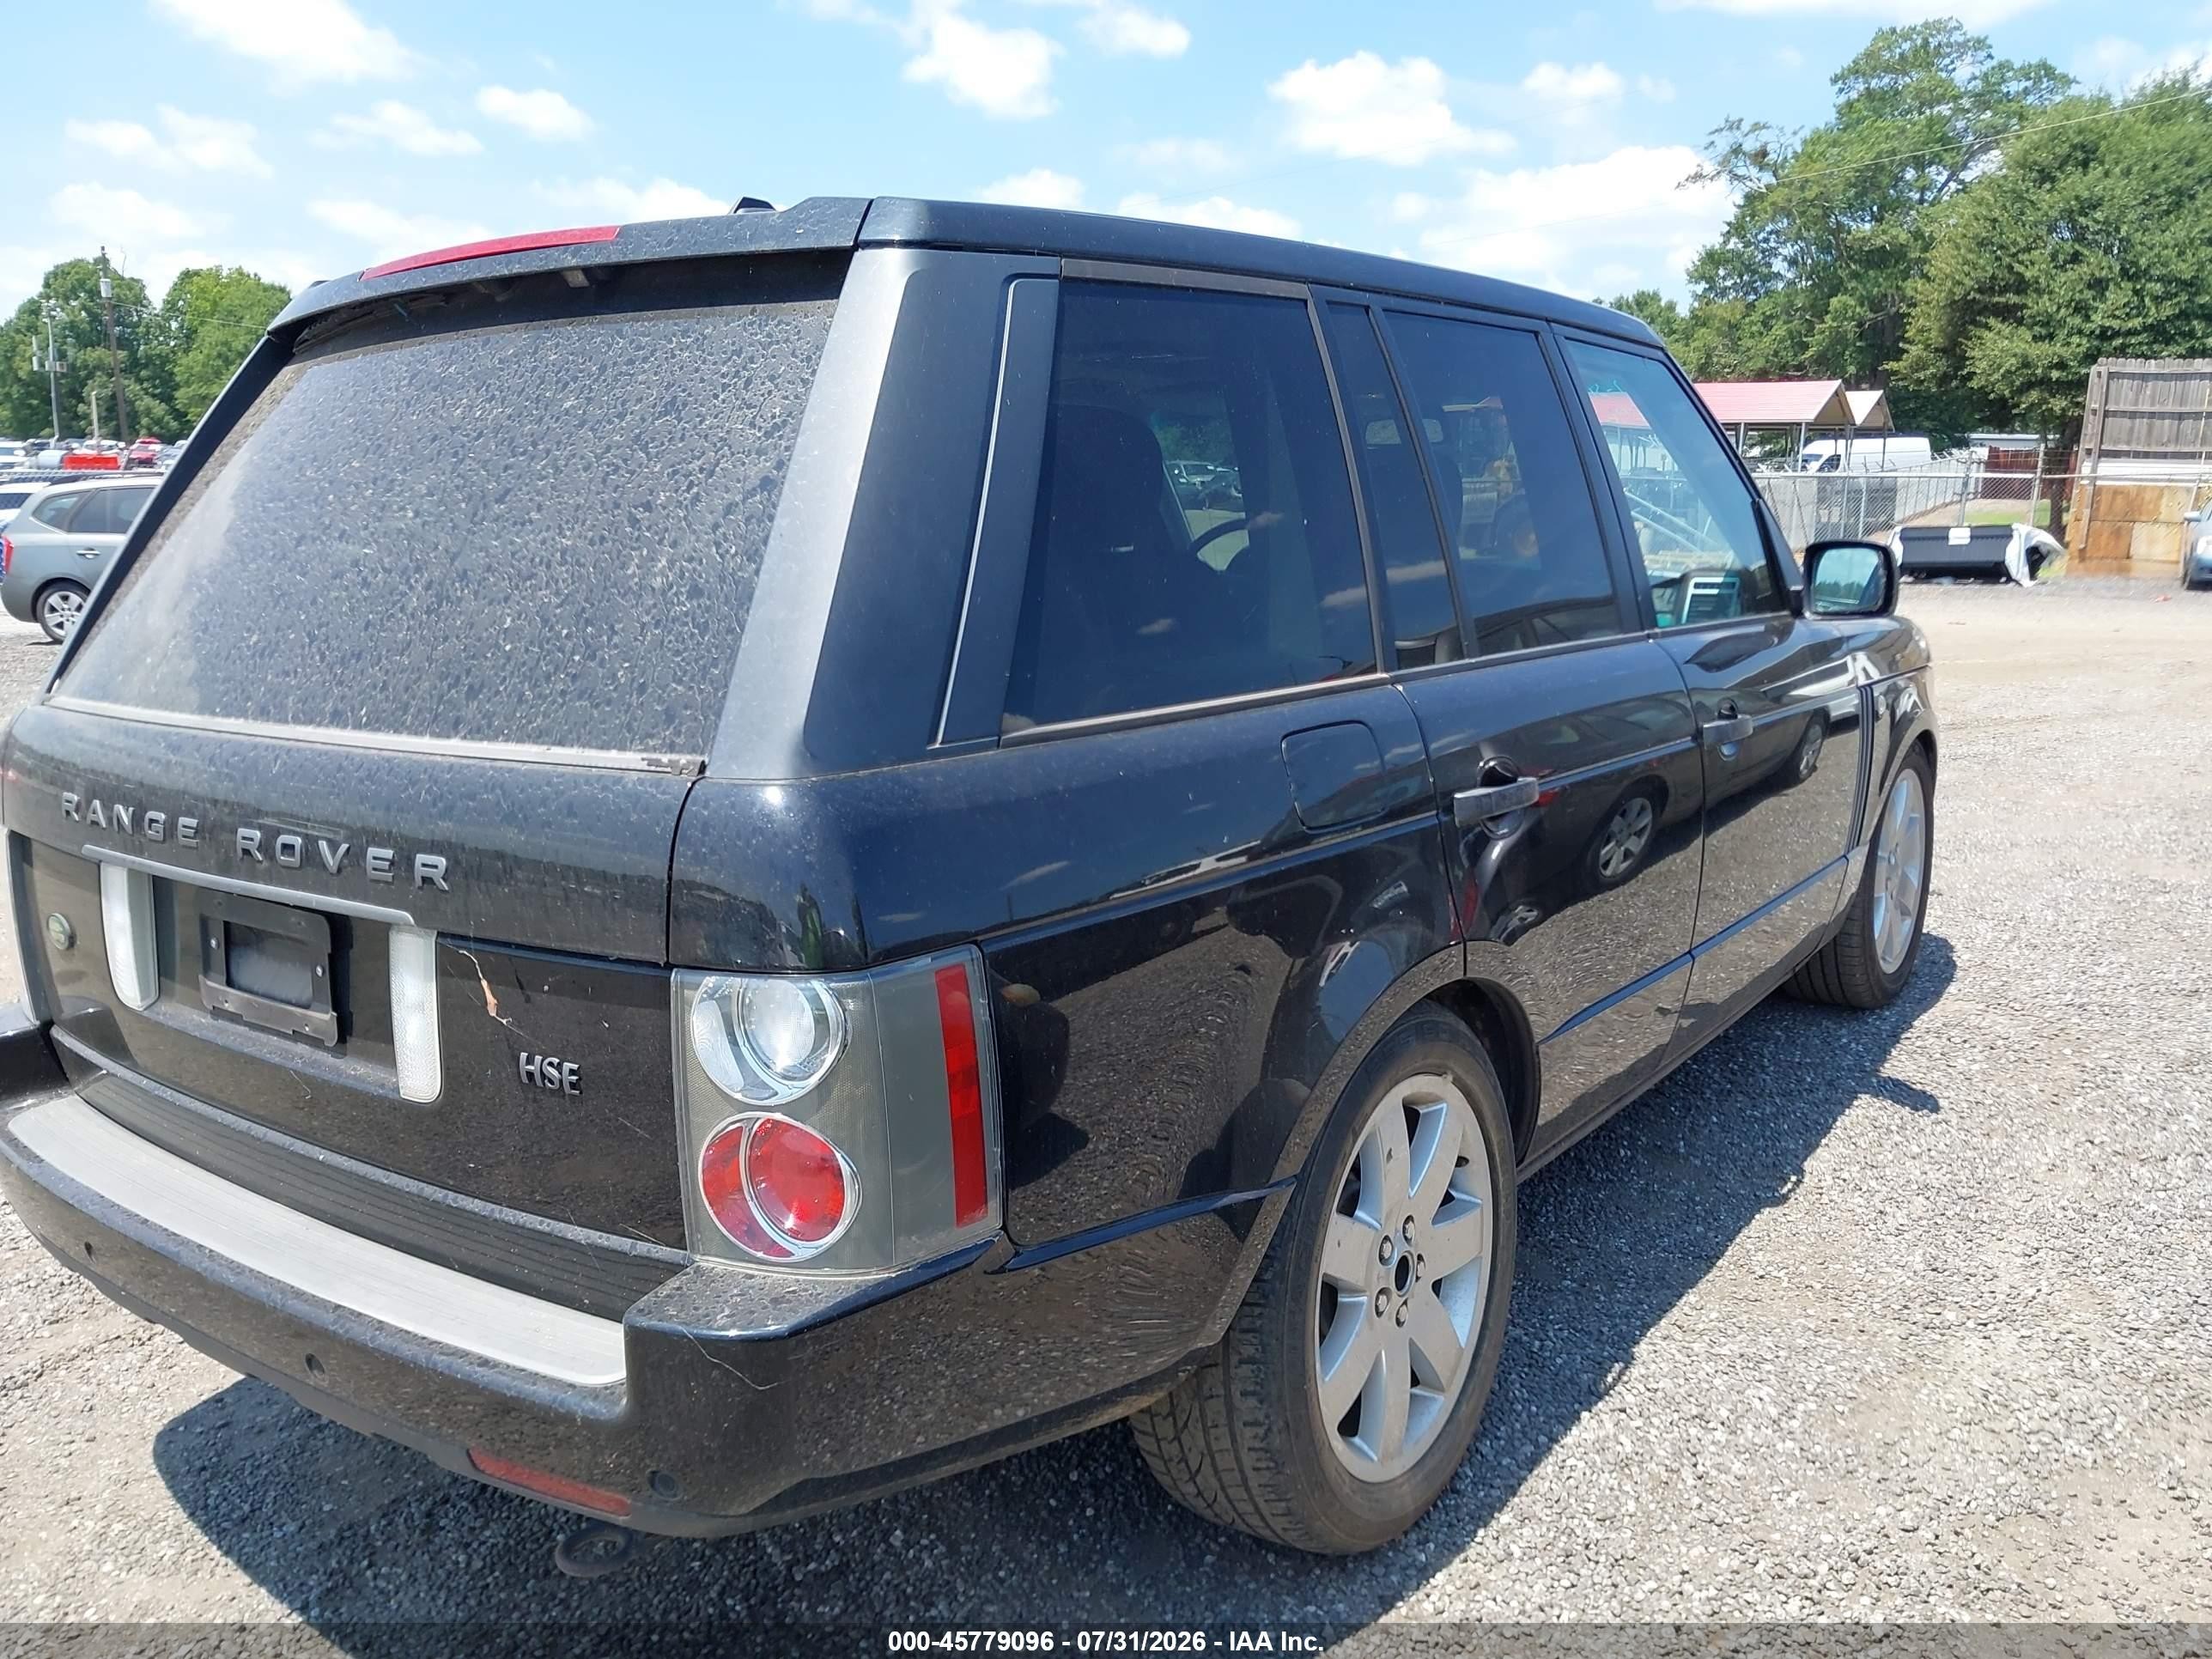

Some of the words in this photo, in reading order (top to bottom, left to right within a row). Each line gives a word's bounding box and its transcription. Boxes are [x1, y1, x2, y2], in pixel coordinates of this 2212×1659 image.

[61, 792, 199, 848] RANGE
[236, 828, 448, 891] ROVER
[520, 1052, 580, 1096] HSE
